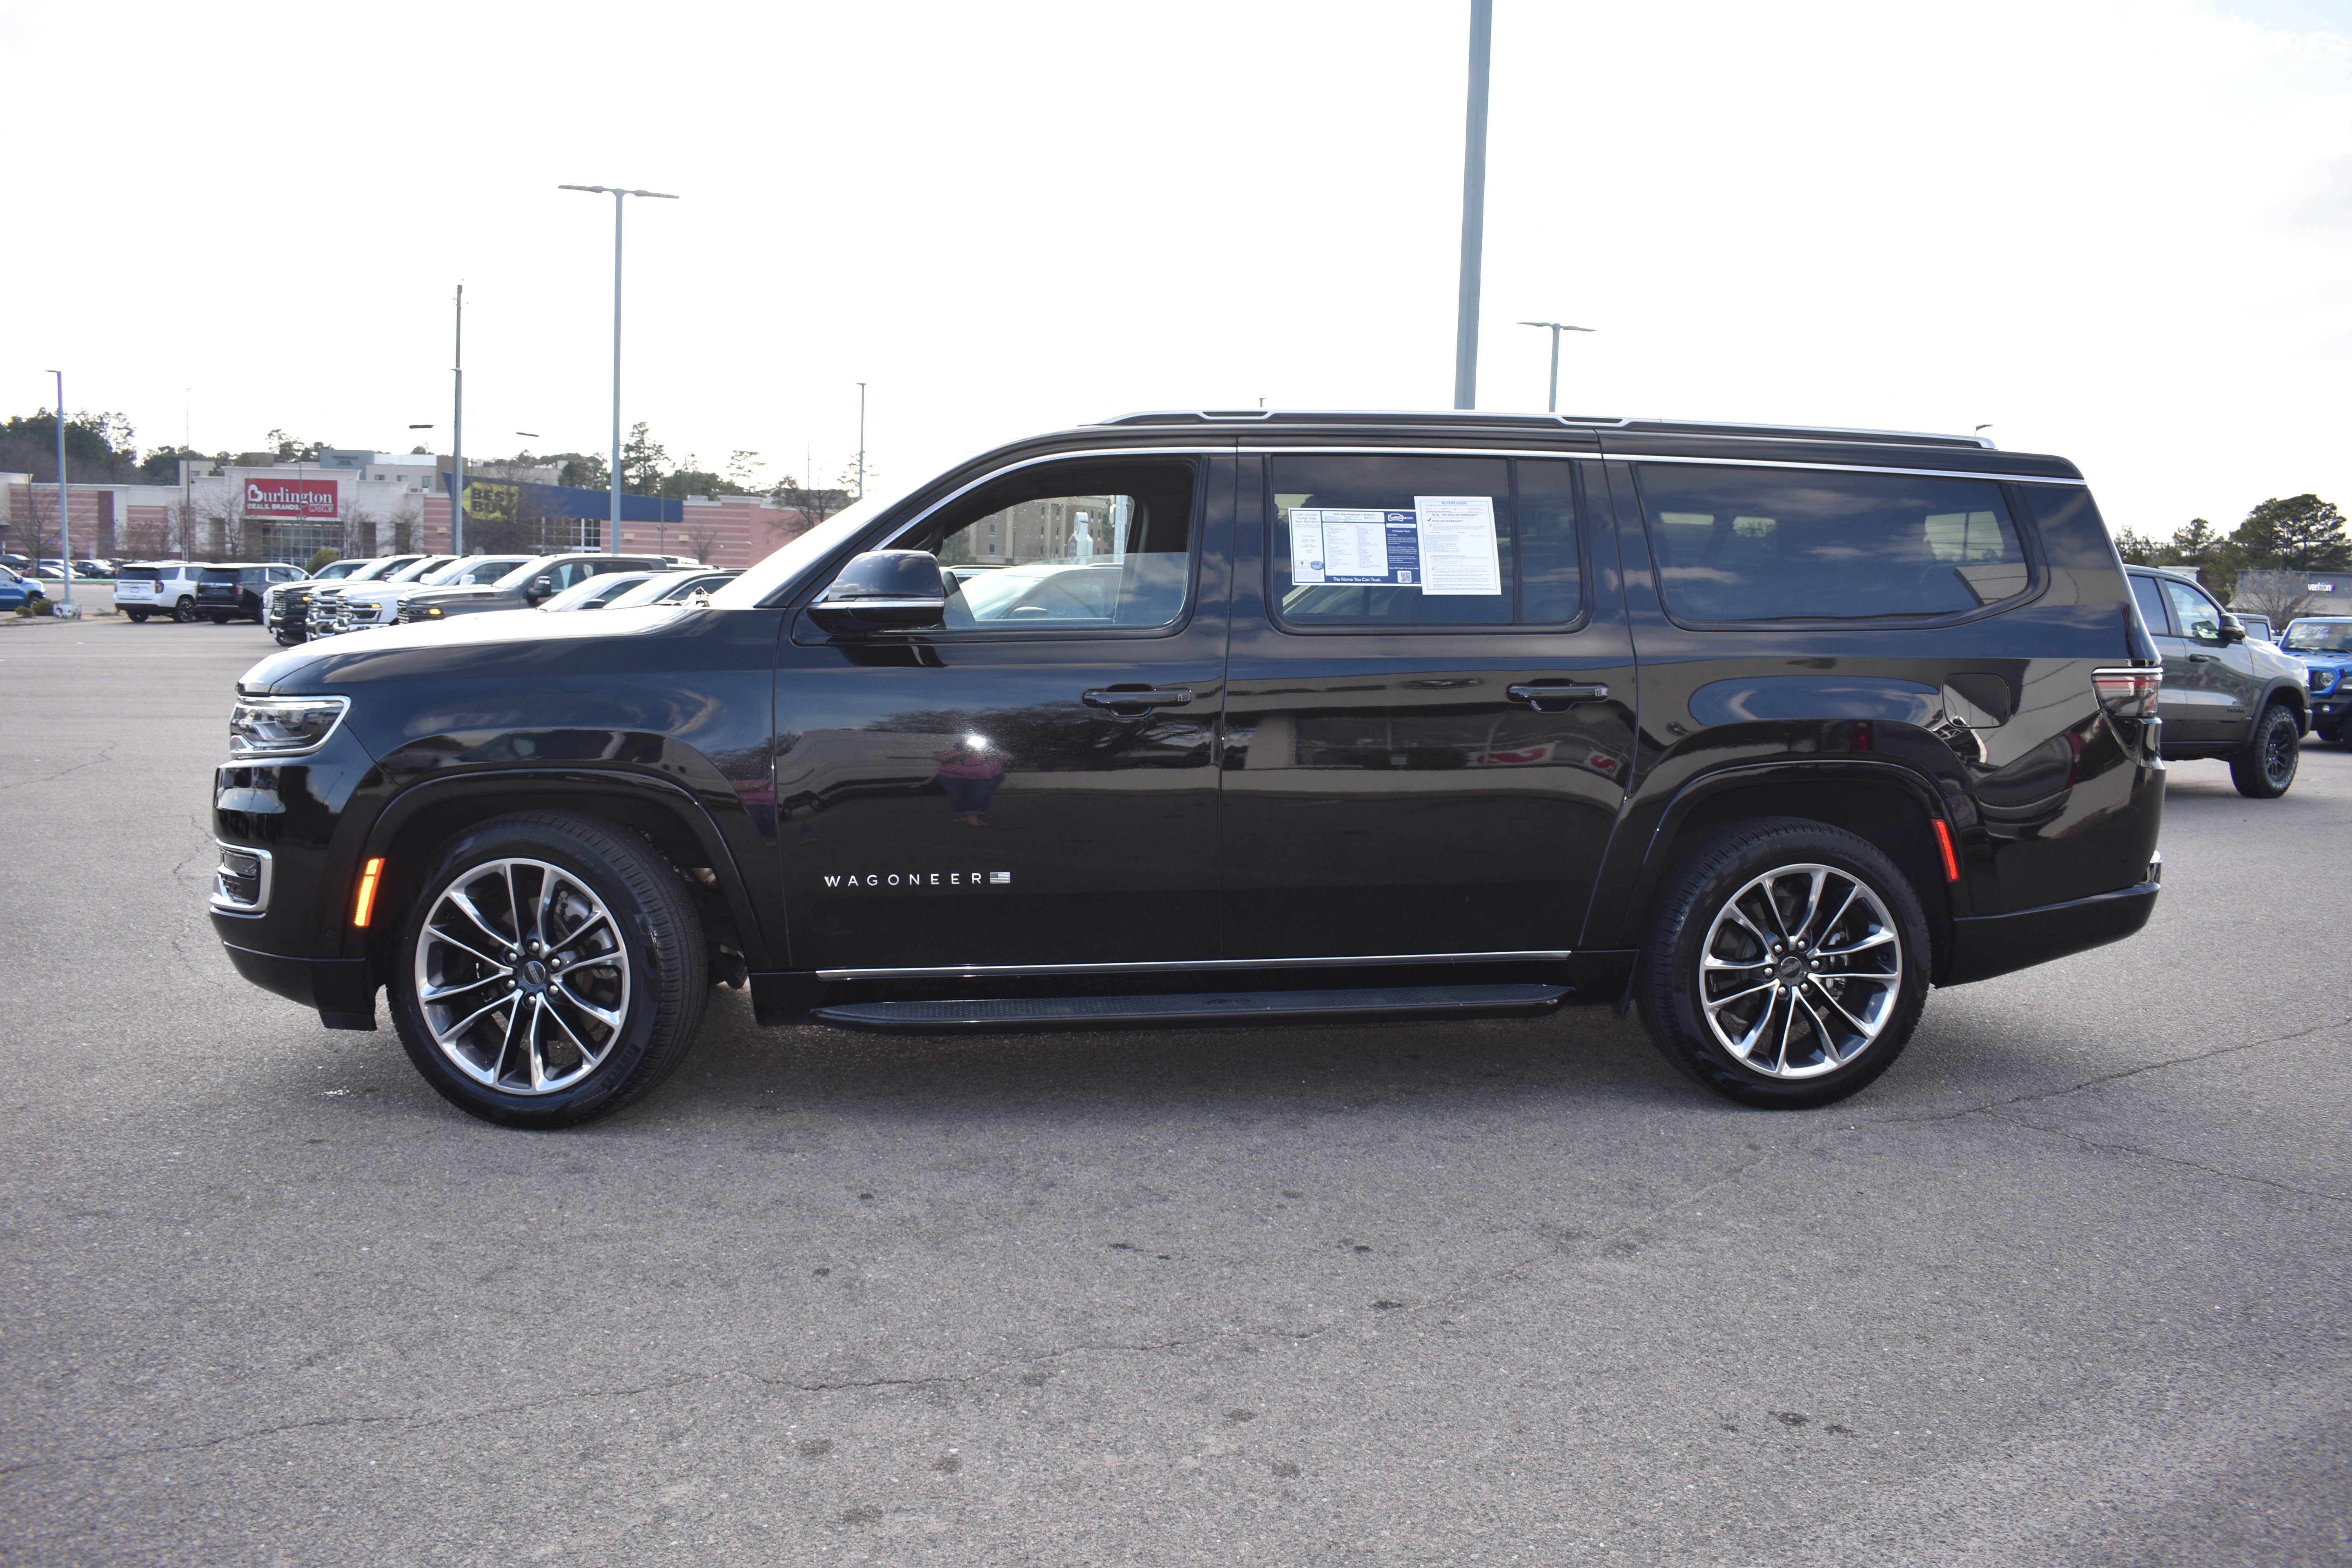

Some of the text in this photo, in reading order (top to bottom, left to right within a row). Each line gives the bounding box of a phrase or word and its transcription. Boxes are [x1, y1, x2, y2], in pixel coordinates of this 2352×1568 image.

[247, 484, 332, 508] Burlington
[472, 488, 516, 503] BEST
[2307, 582, 2332, 592] verizon
[824, 873, 982, 887] WAGONEER
